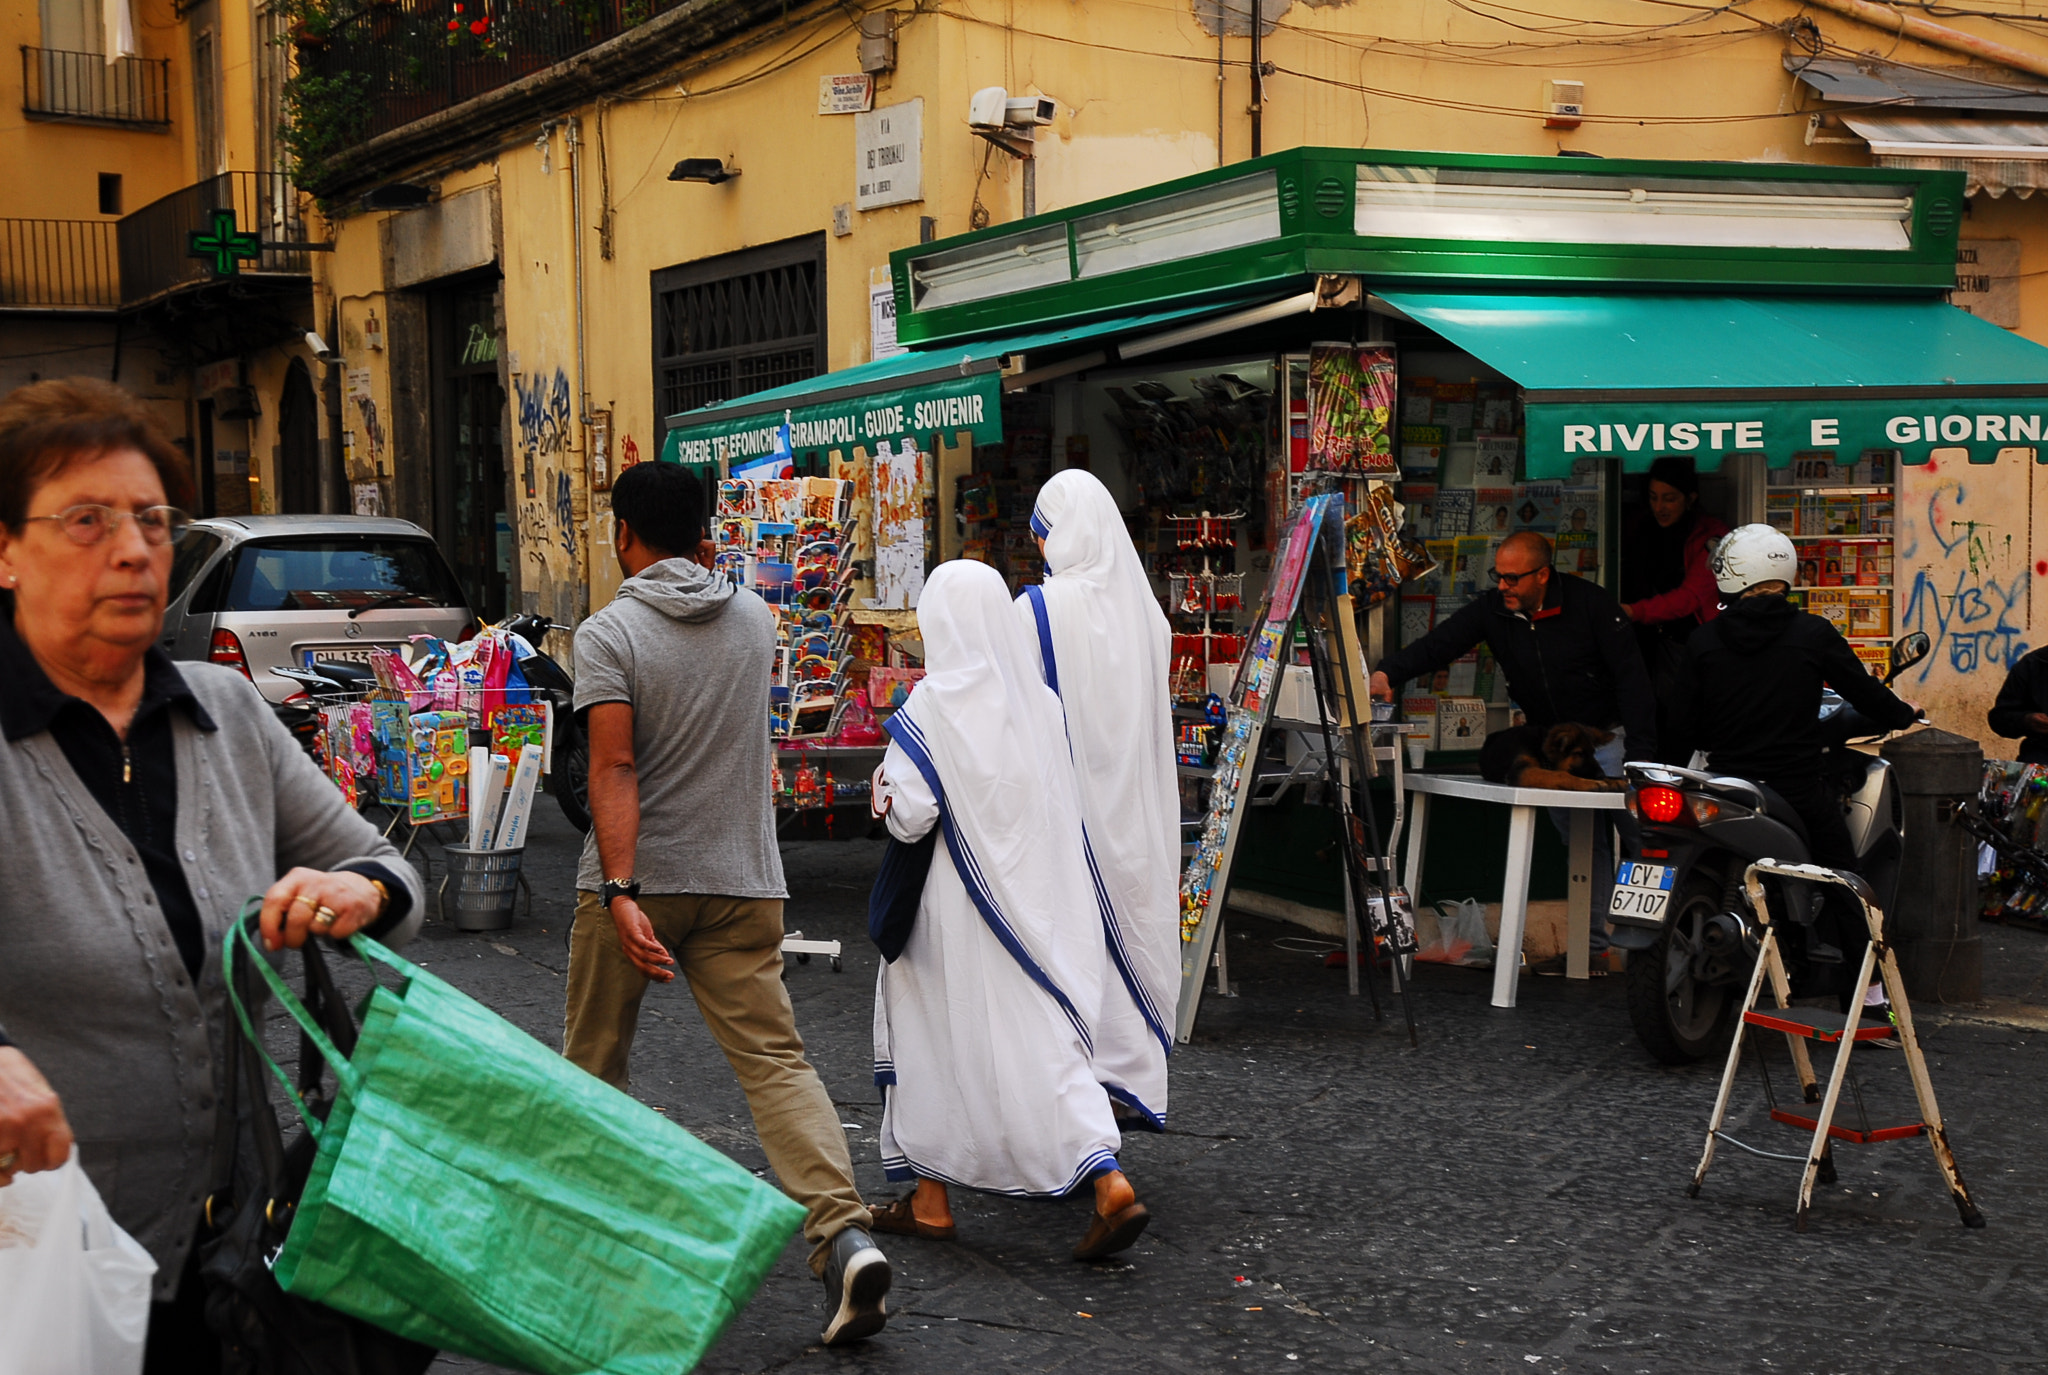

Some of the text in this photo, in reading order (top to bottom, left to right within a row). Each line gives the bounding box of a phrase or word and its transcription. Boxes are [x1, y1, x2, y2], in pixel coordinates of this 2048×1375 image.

[880, 117, 890, 134] VIA
[867, 143, 904, 169] DEI TRIBUNALI
[1954, 273, 1990, 293] AETANO
[678, 436, 712, 464] SCHEDE
[788, 416, 856, 449] GIRANAPOLI
[864, 405, 904, 439] GUIDE
[914, 394, 985, 430] SOUVENIR
[1313, 425, 1374, 453] SERPETI
[1563, 414, 2048, 453] RIVISTE E GIORN
[1332, 450, 1394, 469] VEENOSI
[1810, 592, 1844, 603] RELAX
[505, 815, 520, 848] Callejón
[1612, 890, 1667, 915] 67107
